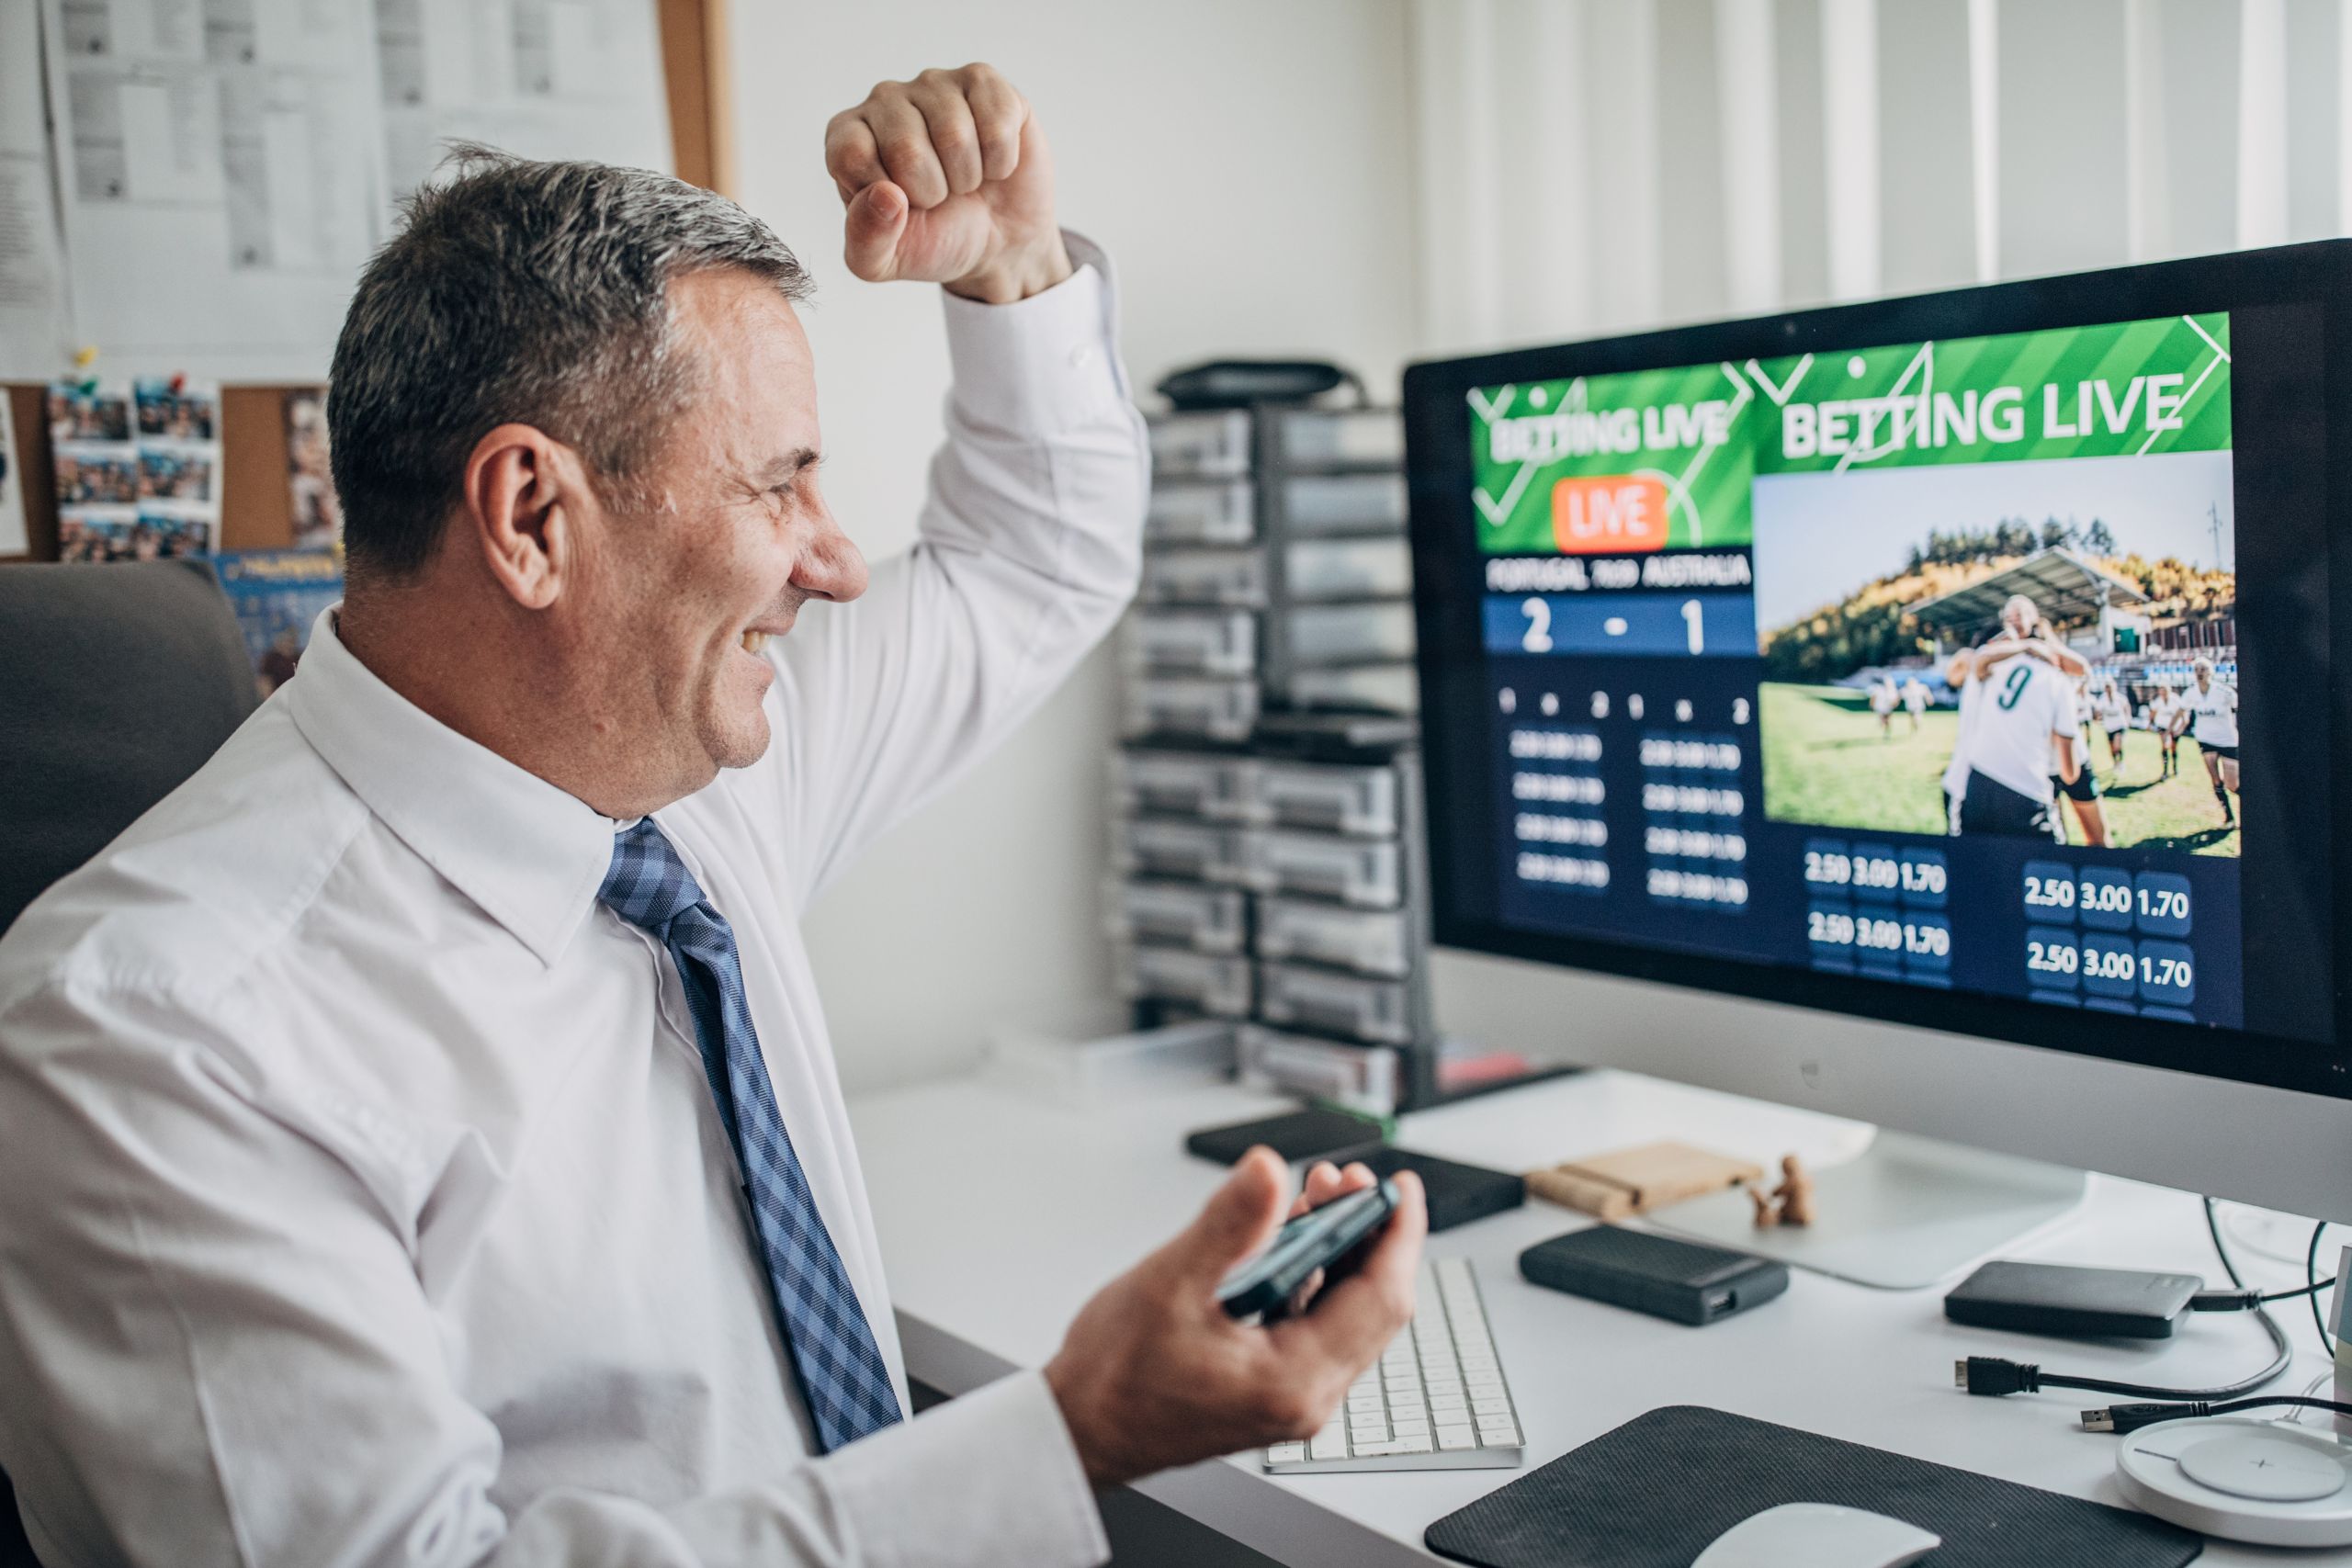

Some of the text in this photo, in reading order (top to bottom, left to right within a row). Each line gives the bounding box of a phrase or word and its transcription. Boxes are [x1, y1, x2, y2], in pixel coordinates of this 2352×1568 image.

[1489, 399, 1729, 464] BETTING LIVE
[1781, 372, 2185, 460] BETTING LIVE
[1567, 484, 1649, 538] LIVE
[1521, 597, 1554, 653] 2
[1680, 598, 1704, 655] 1
[1996, 663, 2032, 711] 9
[2024, 876, 2189, 919] 2.50 3.00 1.70
[2027, 941, 2192, 988] 2.50 3.00 1.70
